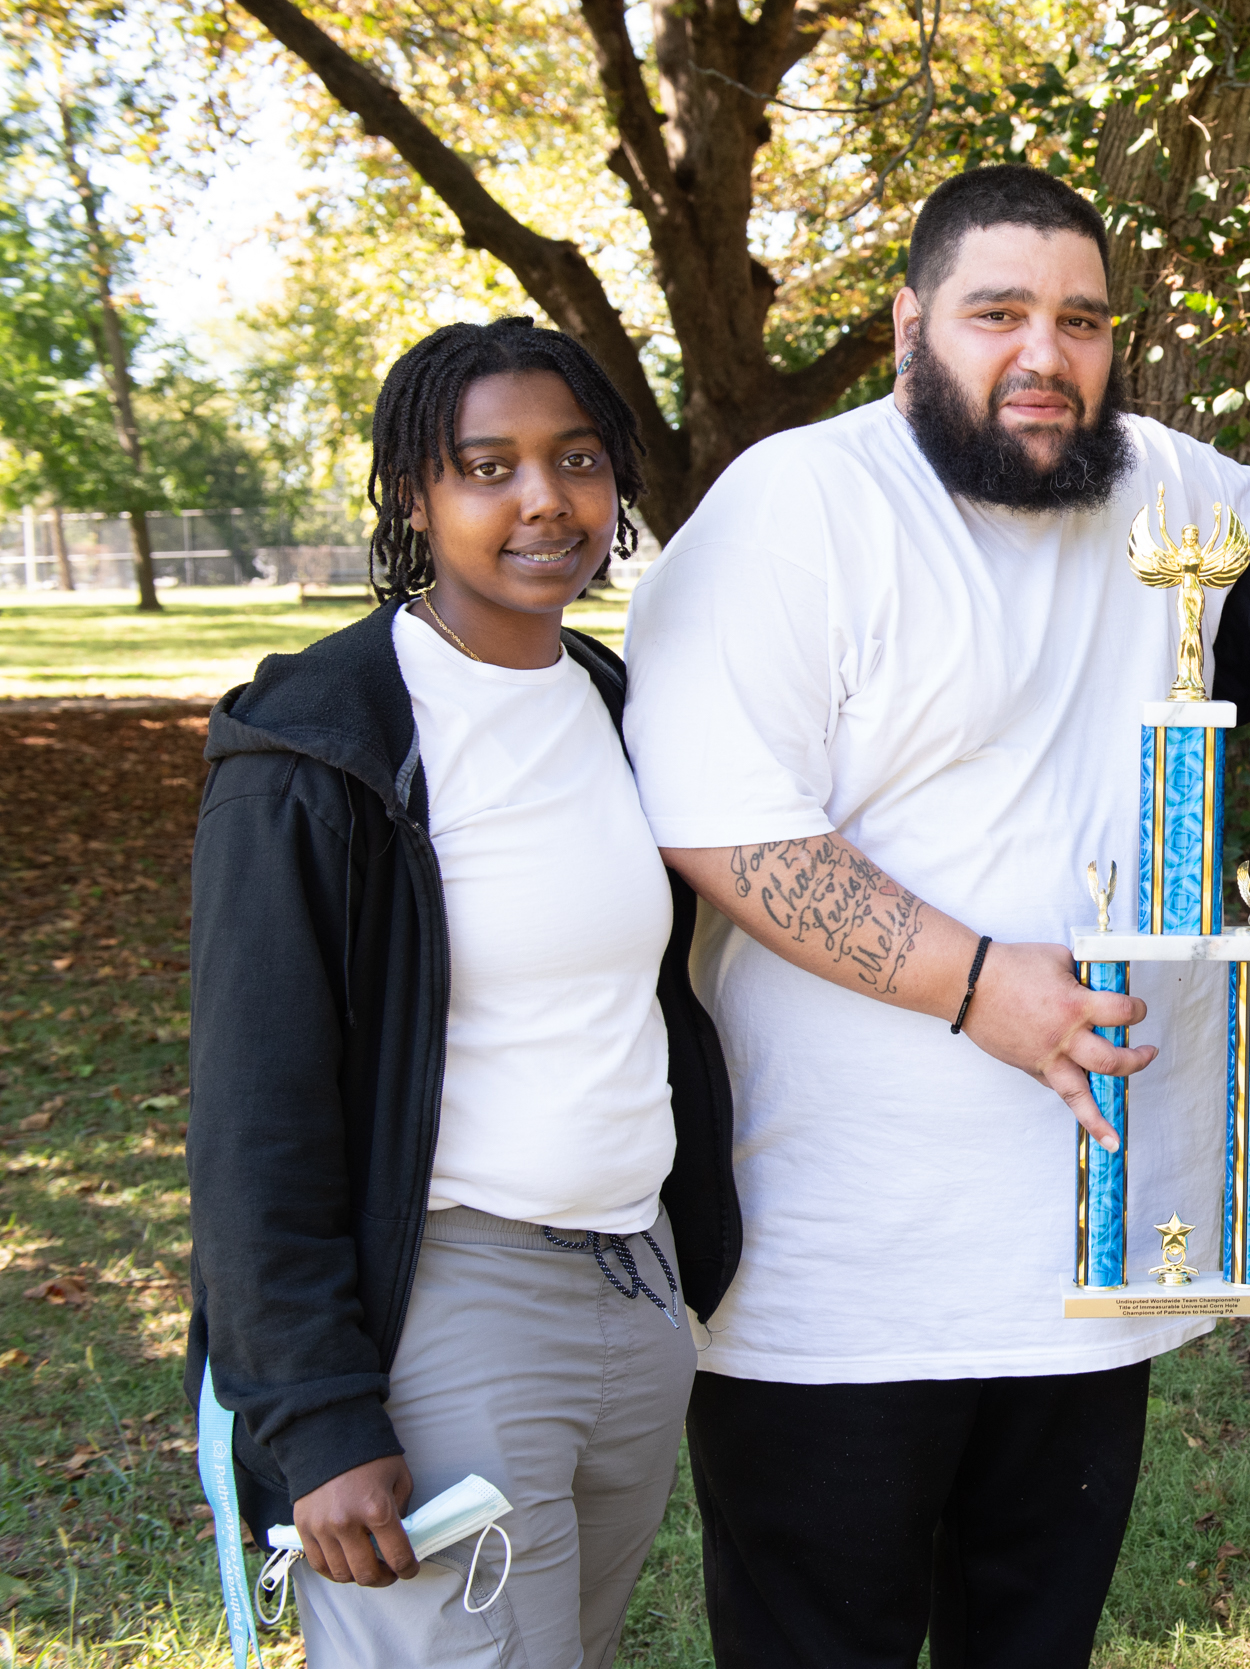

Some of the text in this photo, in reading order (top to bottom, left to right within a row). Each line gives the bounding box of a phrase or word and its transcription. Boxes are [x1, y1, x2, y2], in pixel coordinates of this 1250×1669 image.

[762, 834, 838, 929] Chanel
[812, 875, 860, 951] Luis
[214, 1463, 236, 1544] Pathways
[229, 1545, 238, 1562] to
